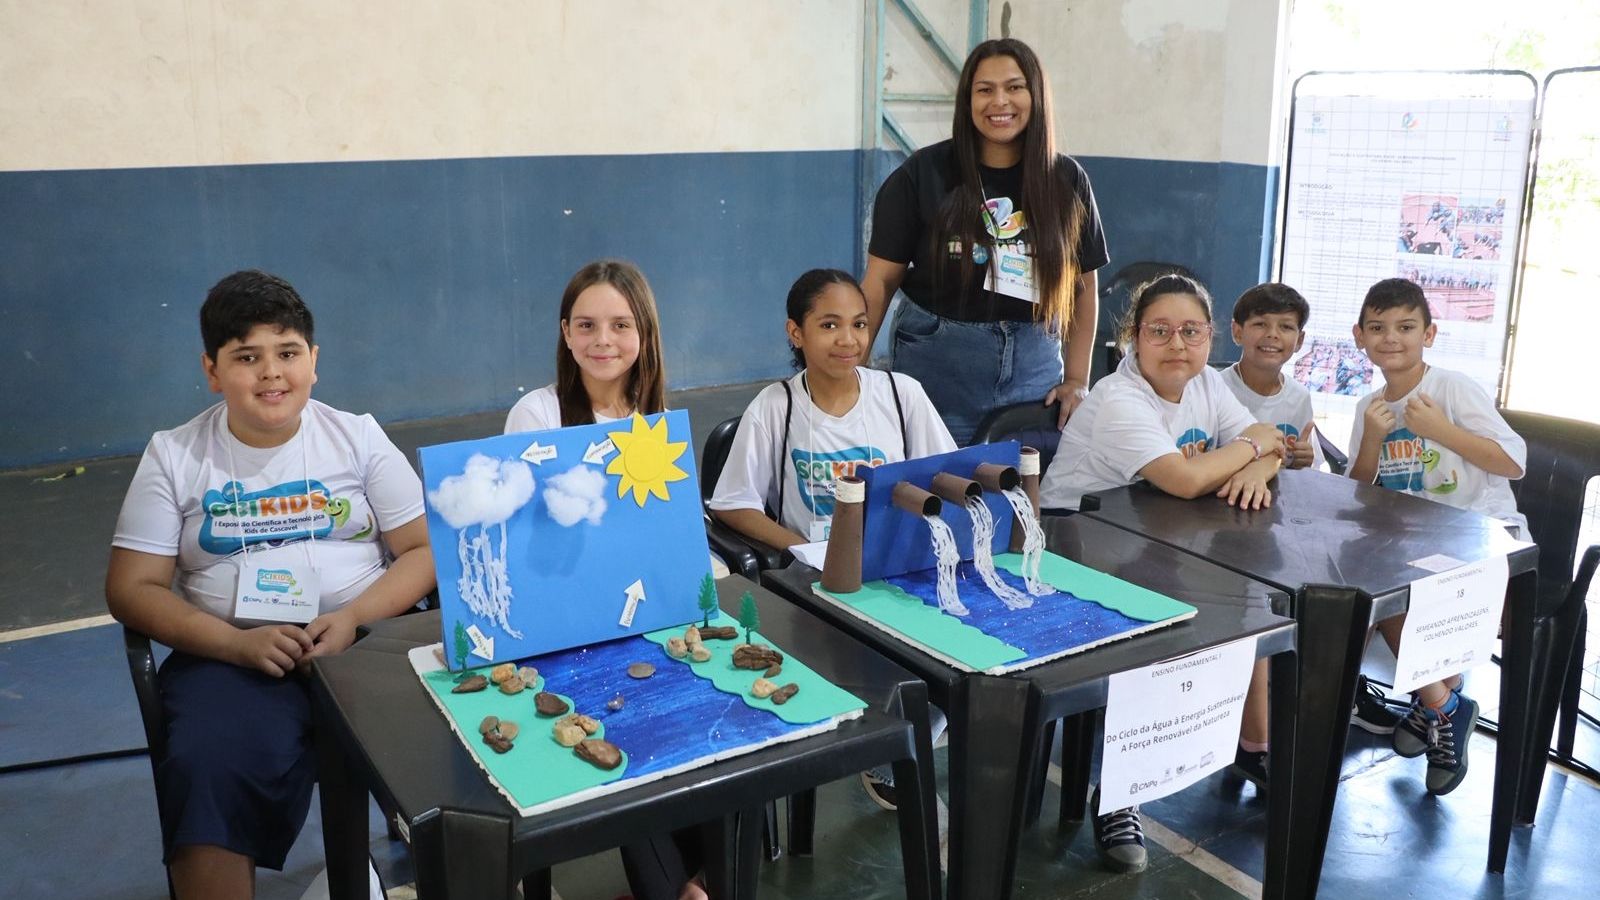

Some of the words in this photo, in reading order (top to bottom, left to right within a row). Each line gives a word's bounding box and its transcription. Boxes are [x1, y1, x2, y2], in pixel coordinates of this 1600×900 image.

[1382, 438, 1422, 460] IKIDS
[796, 458, 884, 481] SCIKI
[218, 519, 250, 529] Exposião
[251, 519, 282, 528] Científica
[244, 526, 259, 534] Kids
[269, 524, 298, 533] Cascavel
[1457, 589, 1465, 598] 18
[1416, 619, 1446, 634] SEMEANDO
[1423, 627, 1454, 641] COLHENDO
[1152, 666, 1174, 678] ENSINO
[1176, 657, 1218, 671] FUNDAMENTAL
[1180, 680, 1193, 693] 19
[1106, 735, 1117, 744] Do
[1119, 728, 1138, 740] Ciclo
[1140, 724, 1150, 734] da
[1152, 720, 1173, 732] Água
[1174, 717, 1179, 725] à
[1181, 708, 1206, 723] Energia
[1121, 744, 1127, 753] A
[1129, 739, 1151, 751] Força
[1153, 726, 1193, 744] Renovável
[1193, 723, 1201, 733] da
[1203, 710, 1230, 727] Natureza
